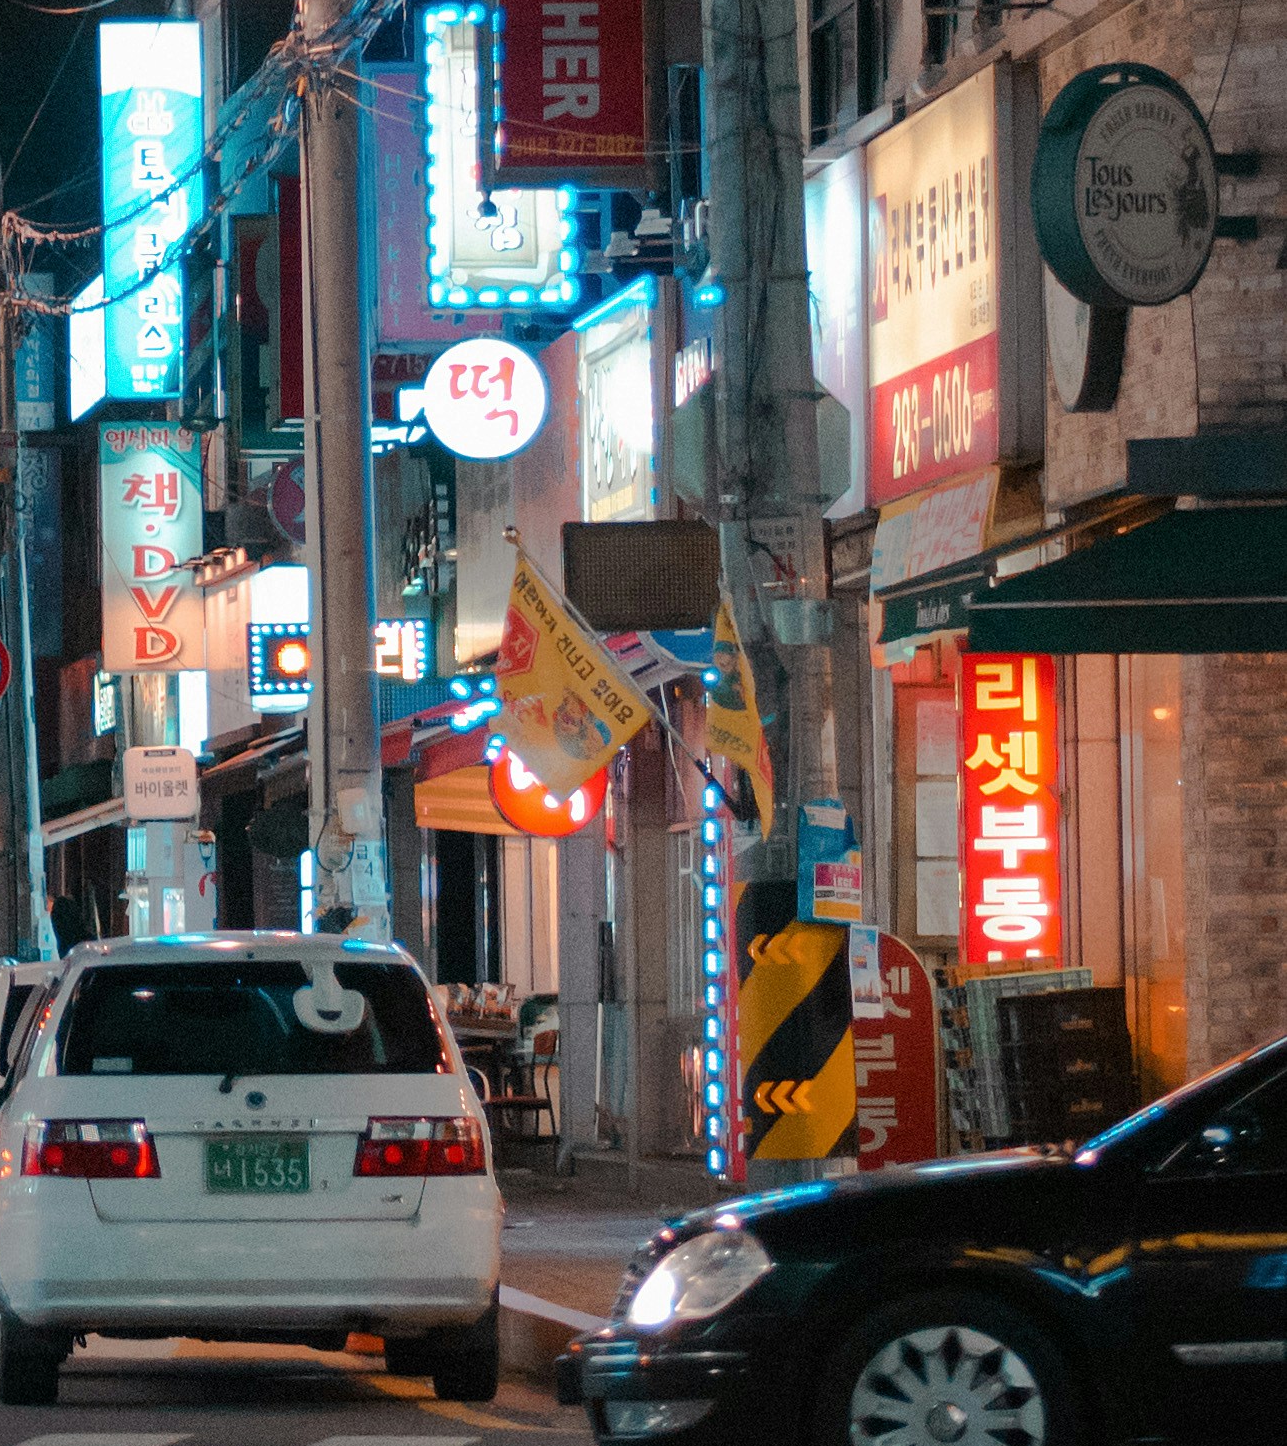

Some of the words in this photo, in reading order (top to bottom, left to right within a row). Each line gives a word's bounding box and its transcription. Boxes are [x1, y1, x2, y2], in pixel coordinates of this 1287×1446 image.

[540, 12, 602, 122] HER
[1084, 155, 1134, 187] Tous
[446, 357, 518, 437] 떡
[890, 358, 974, 481] 293-0606
[134, 779, 189, 799] 바이올렛
[964, 655, 1054, 964] 리셋부동
[240, 1157, 304, 1189] 1535
